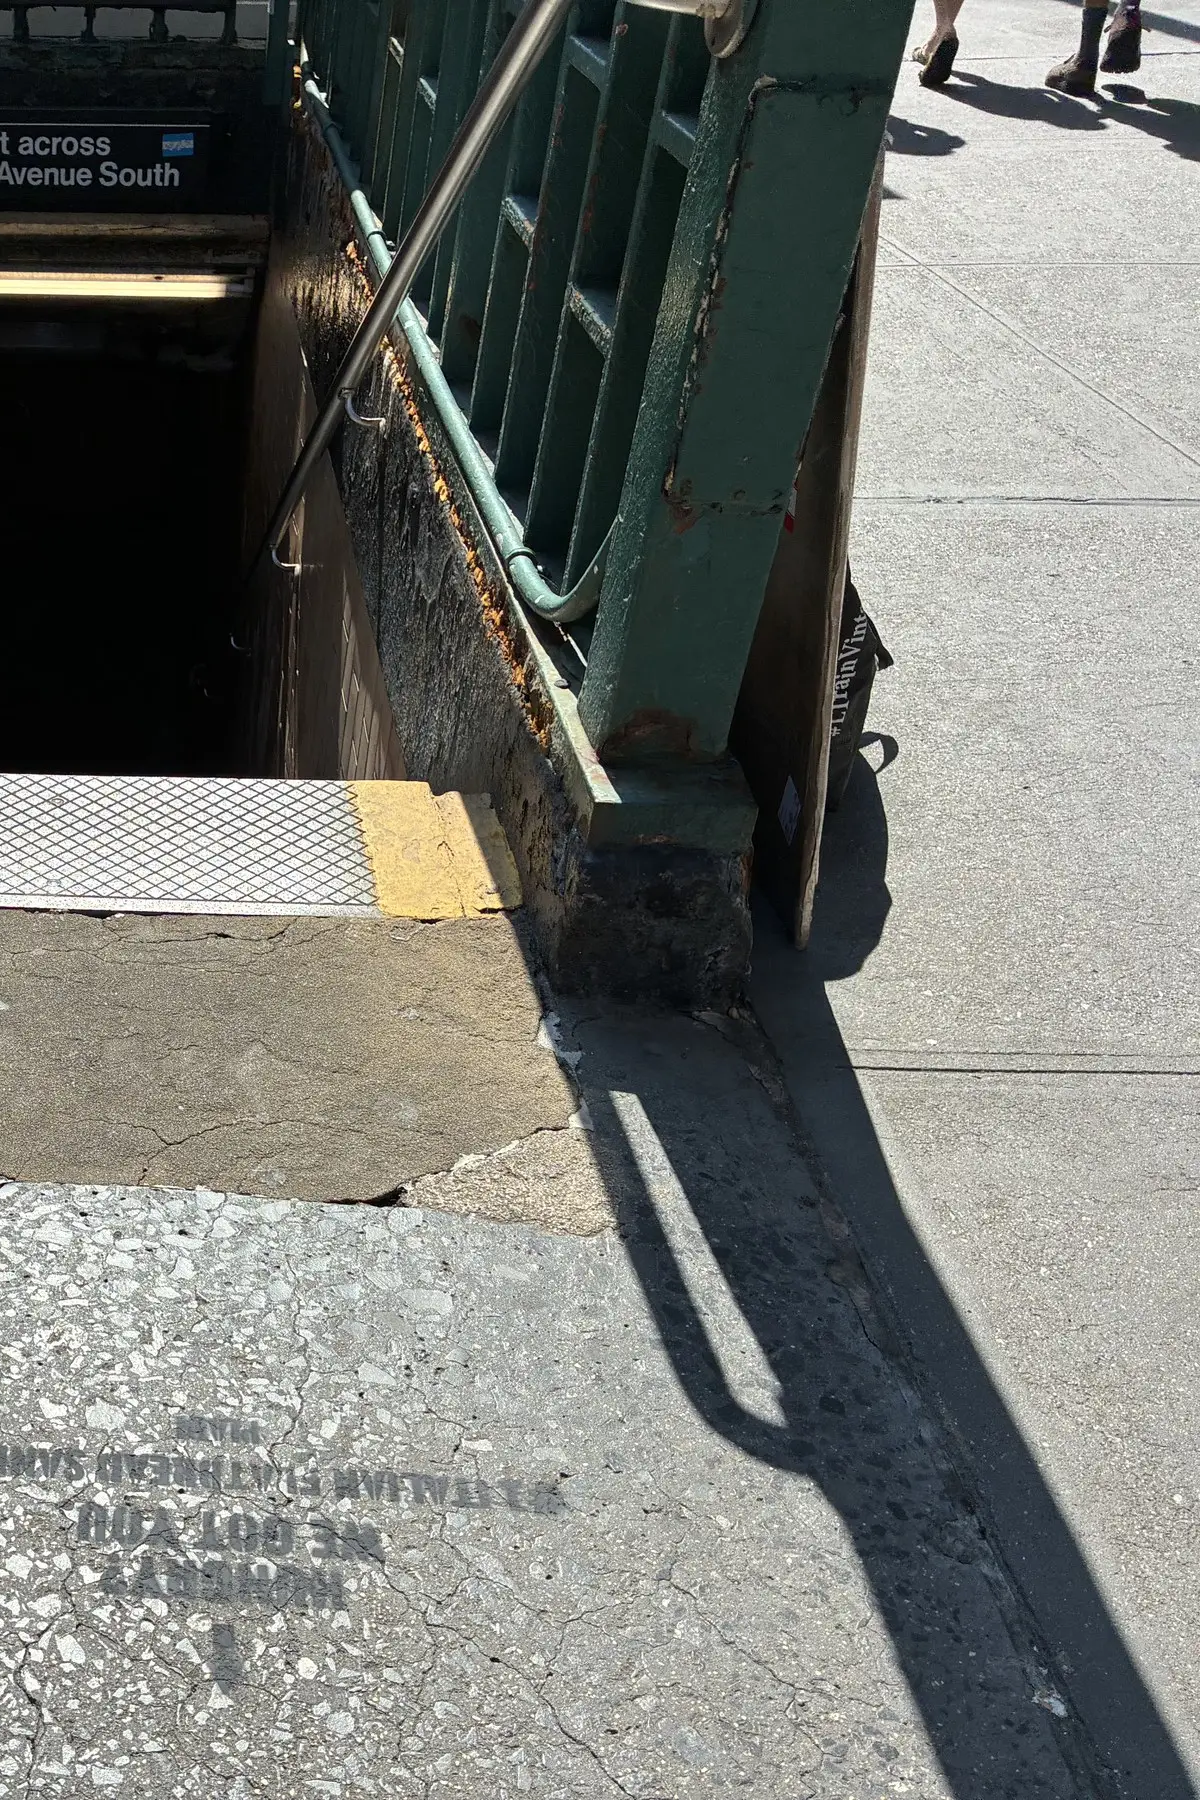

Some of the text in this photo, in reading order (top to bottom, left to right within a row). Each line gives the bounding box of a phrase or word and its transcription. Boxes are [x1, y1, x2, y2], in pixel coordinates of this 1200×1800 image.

[18, 136, 111, 156] across
[99, 161, 180, 187] South
[830, 606, 868, 737] #LTrainVint
[100, 1453, 321, 1497] FLATBREAD
[334, 1468, 494, 1510] ITALIAN
[76, 1502, 387, 1564] WE GOT YOU
